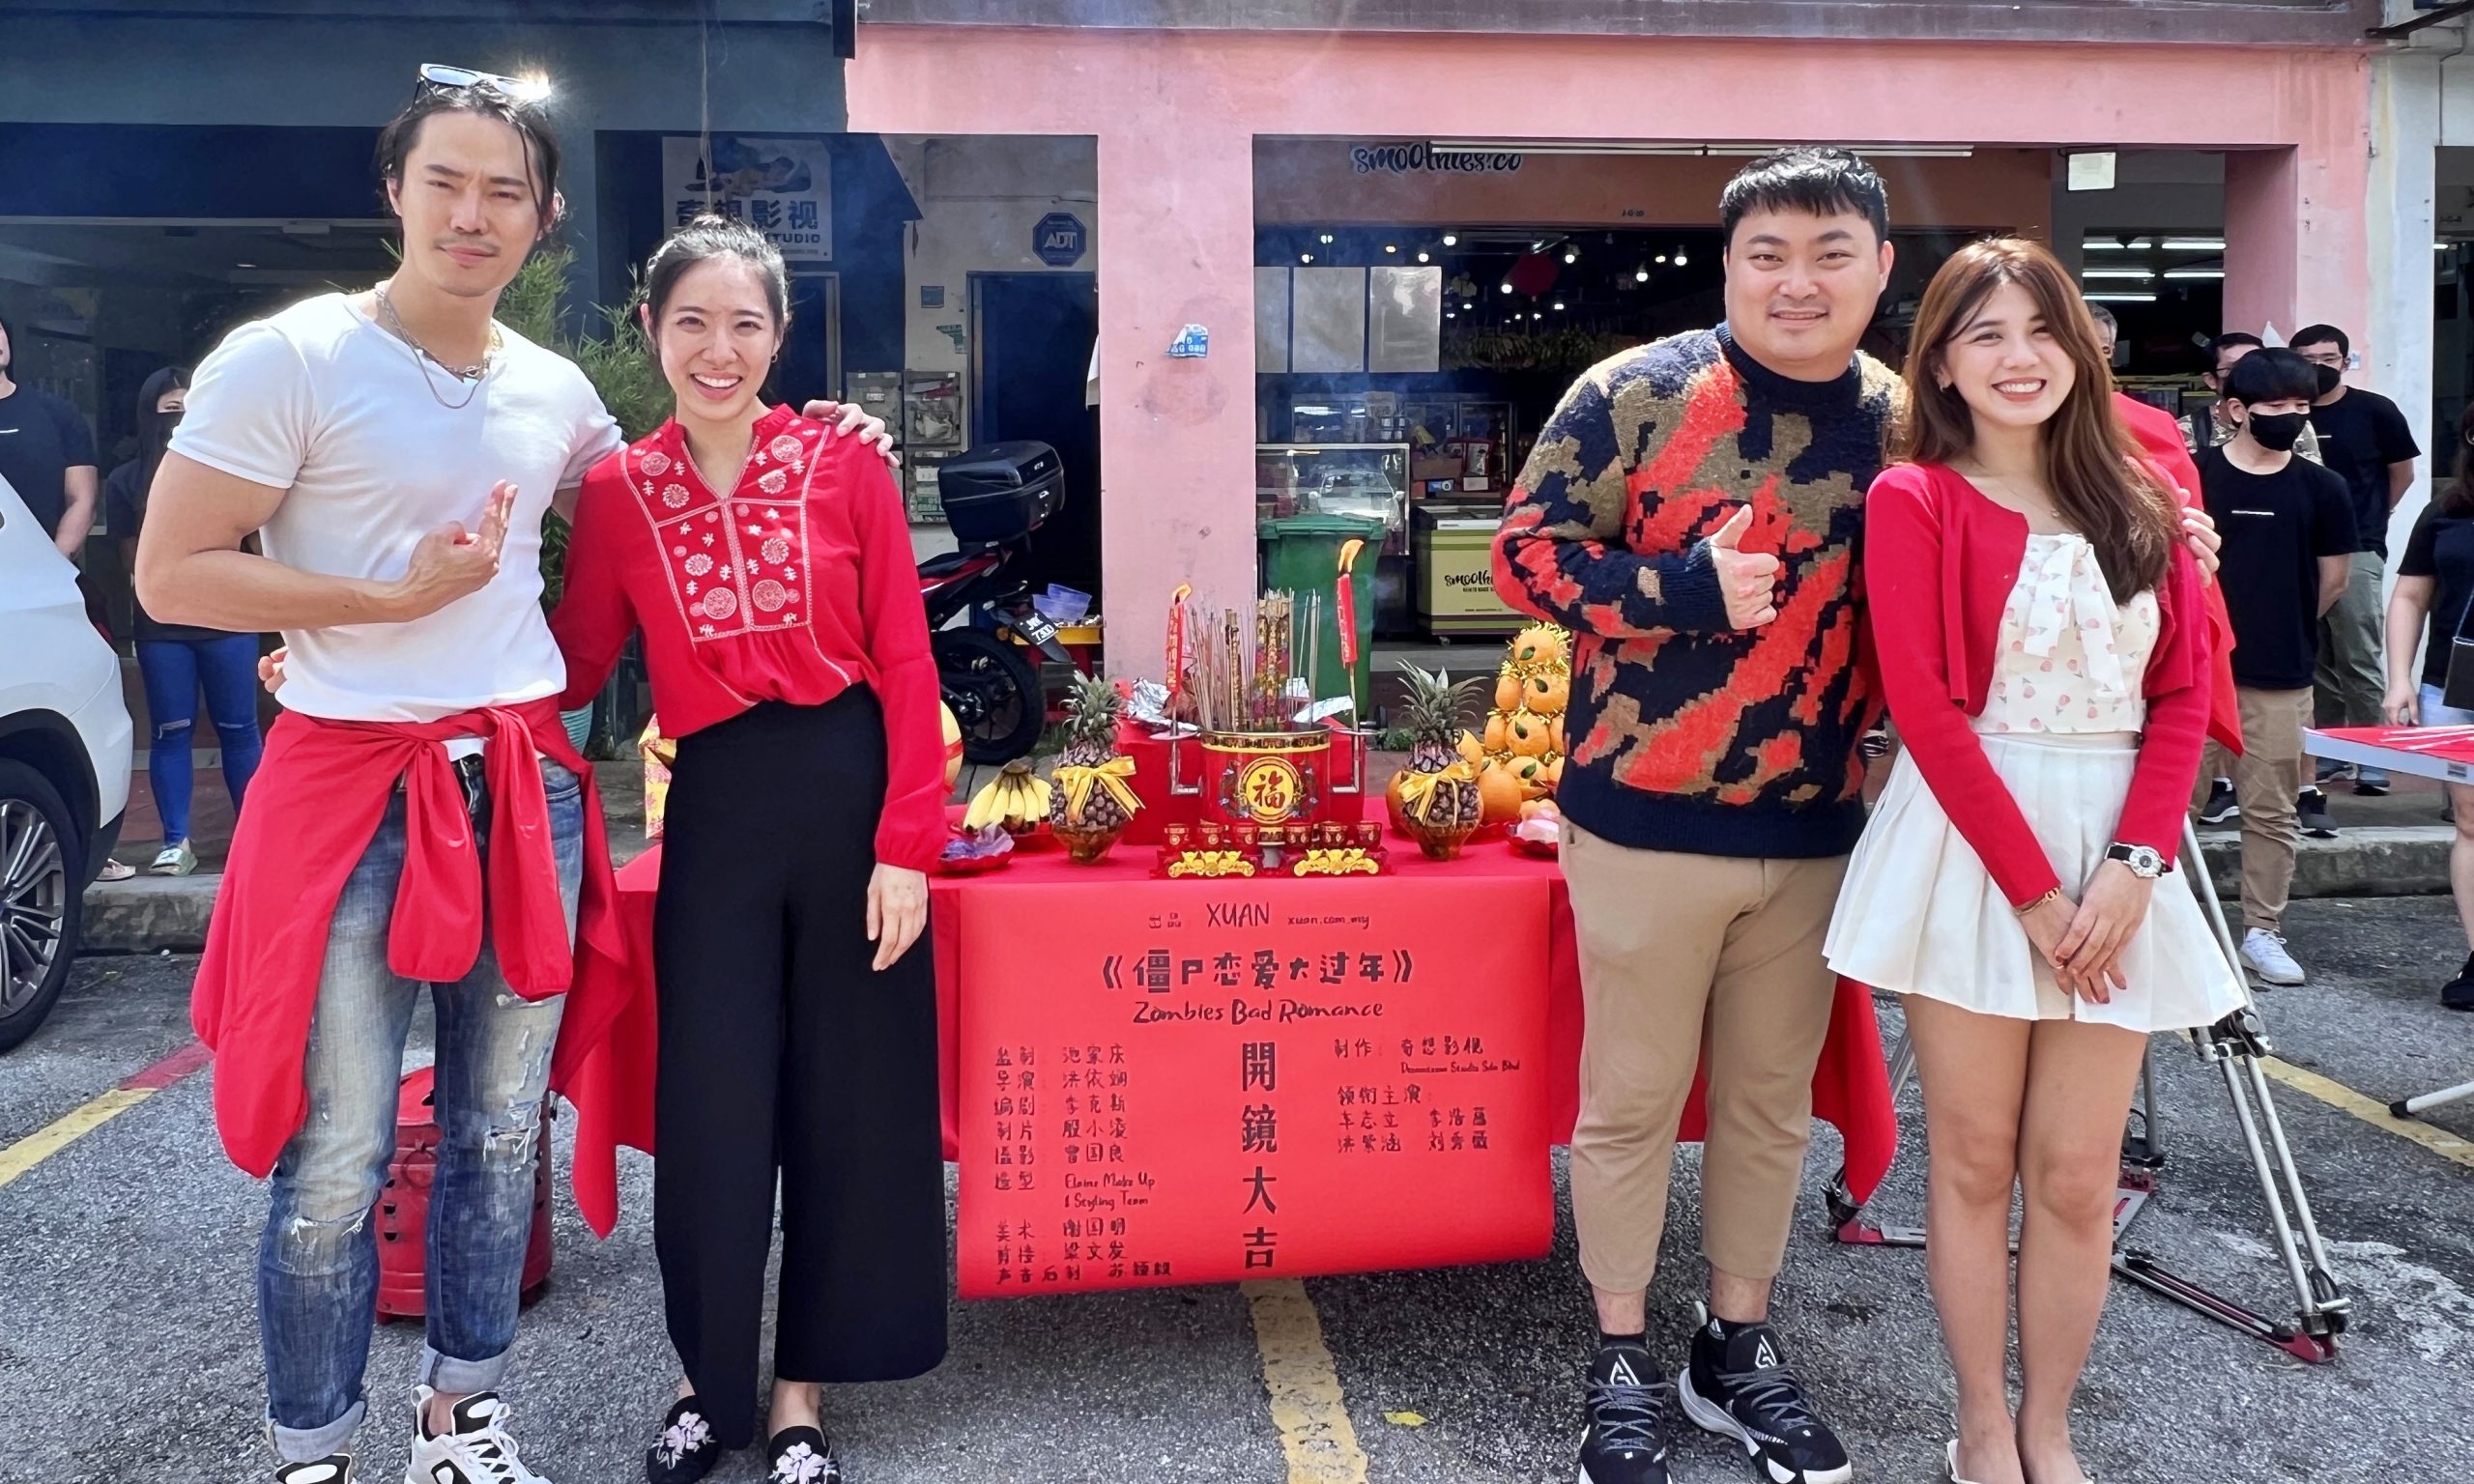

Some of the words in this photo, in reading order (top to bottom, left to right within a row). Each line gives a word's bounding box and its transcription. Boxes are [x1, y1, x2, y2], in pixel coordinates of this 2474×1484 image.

[1044, 231, 1078, 248] ADT
[1252, 770, 1286, 810] 福
[1207, 902, 1269, 928] XUAN
[1133, 1001, 1223, 1023] Zombies
[1232, 999, 1272, 1025] Bad
[1280, 999, 1382, 1023] Romance
[1241, 1042, 1277, 1269] 開鏡大吉
[1138, 1172, 1155, 1190] Up
